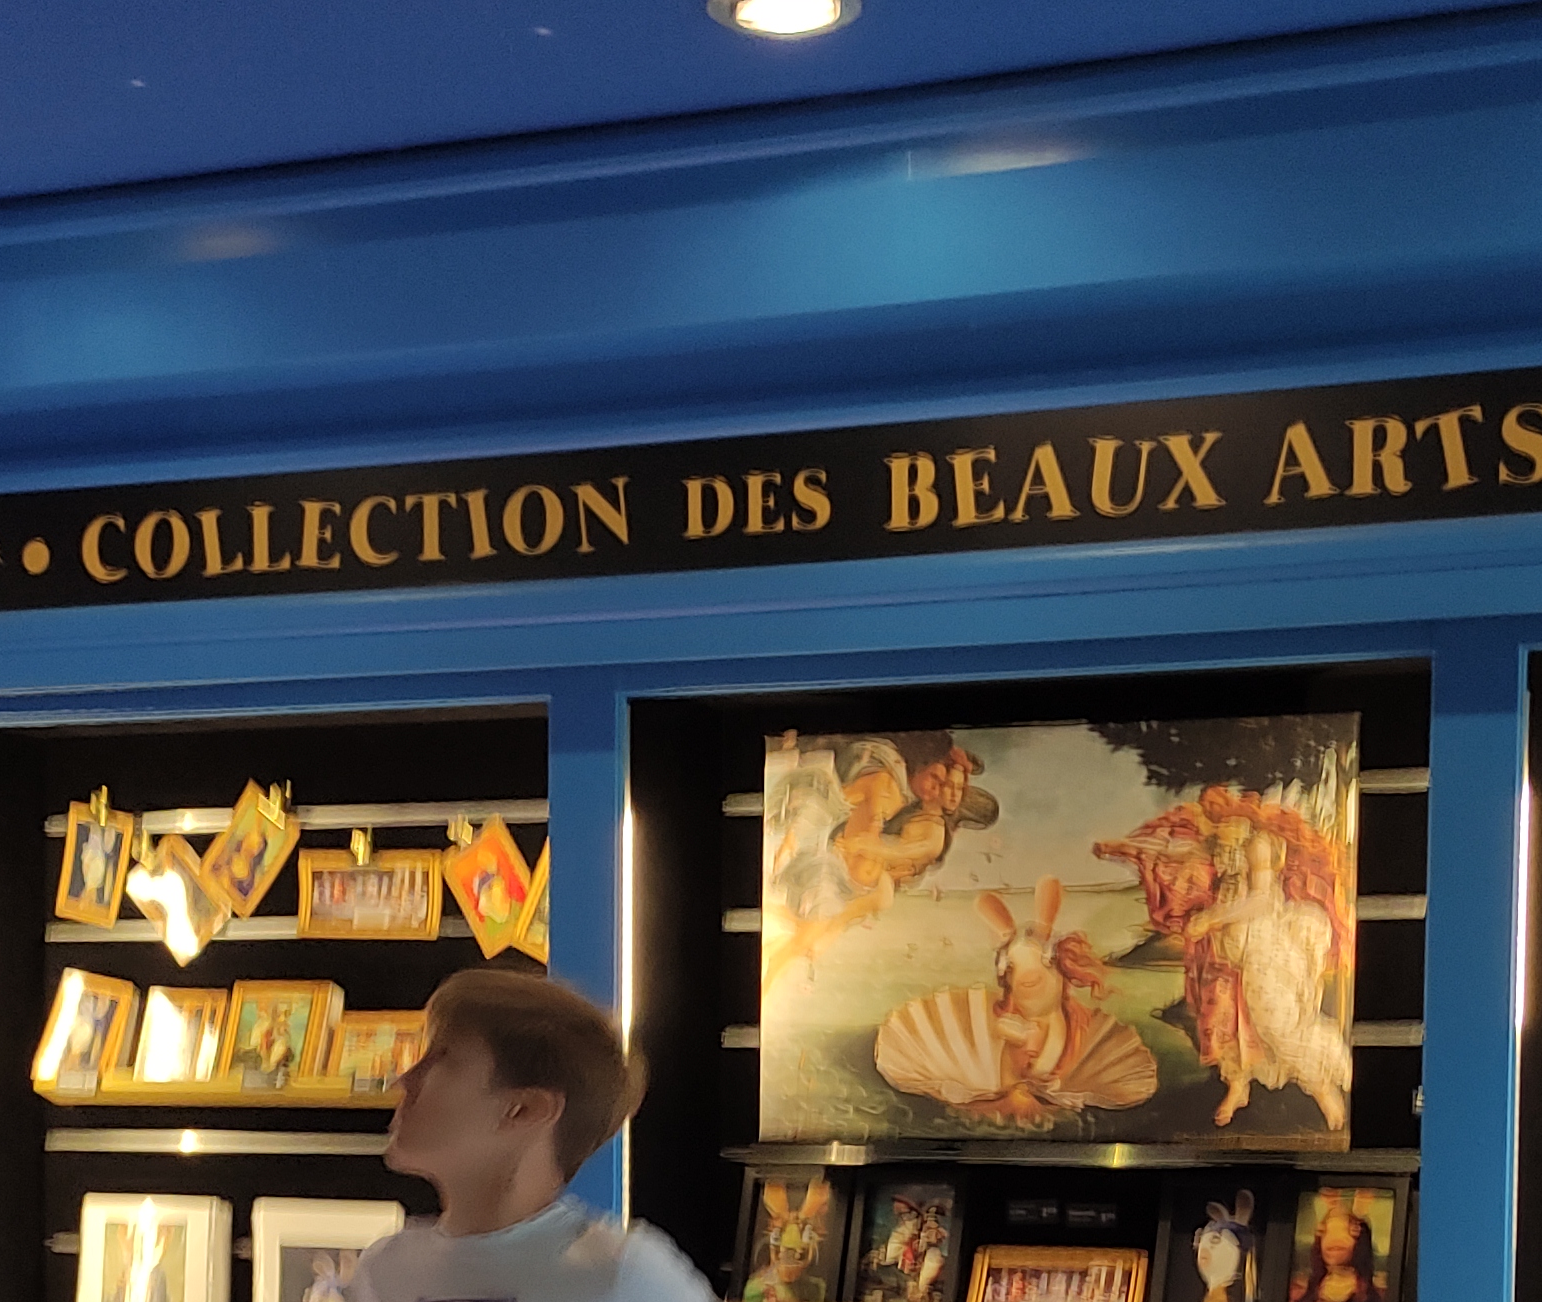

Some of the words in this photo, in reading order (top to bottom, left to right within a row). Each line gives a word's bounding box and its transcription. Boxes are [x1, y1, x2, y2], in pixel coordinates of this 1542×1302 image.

[80, 474, 630, 584] COLLECTION
[681, 467, 832, 540] DES
[883, 430, 1225, 534] BEAUX
